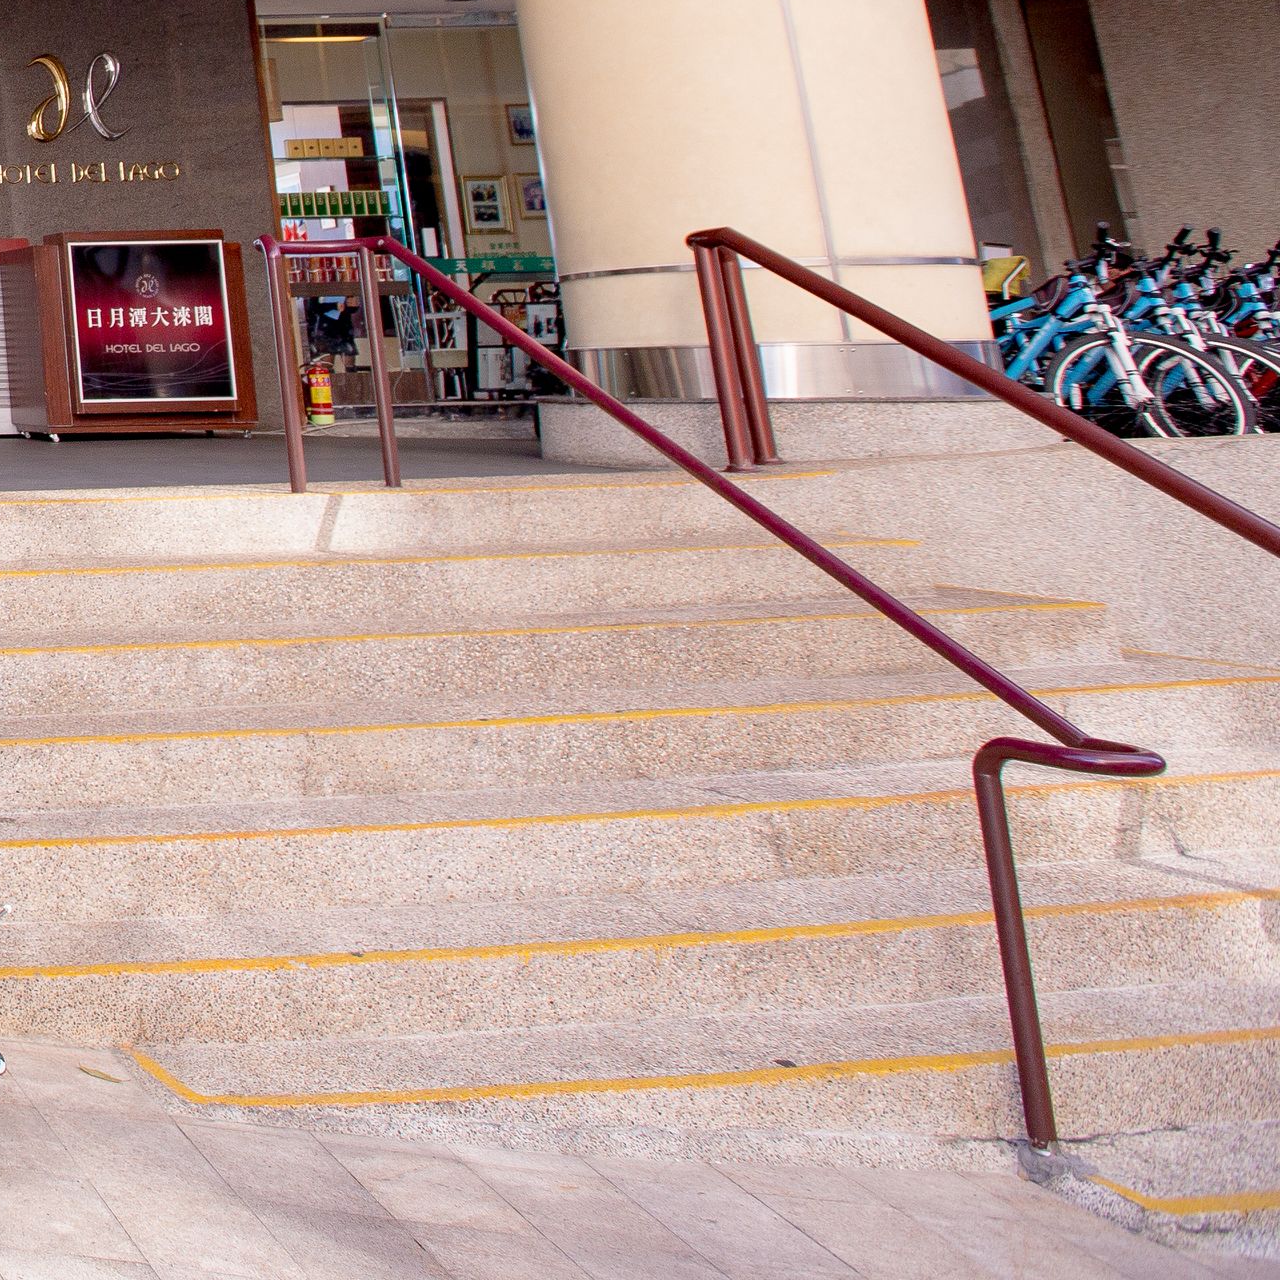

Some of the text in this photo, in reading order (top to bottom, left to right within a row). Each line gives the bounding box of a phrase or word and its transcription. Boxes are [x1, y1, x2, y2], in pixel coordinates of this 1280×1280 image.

[72, 162, 111, 182] DEL
[119, 161, 181, 182] LAGO
[87, 305, 214, 328] 日月潭大淶閣
[105, 342, 201, 354] HOTEL DEL LAGO
